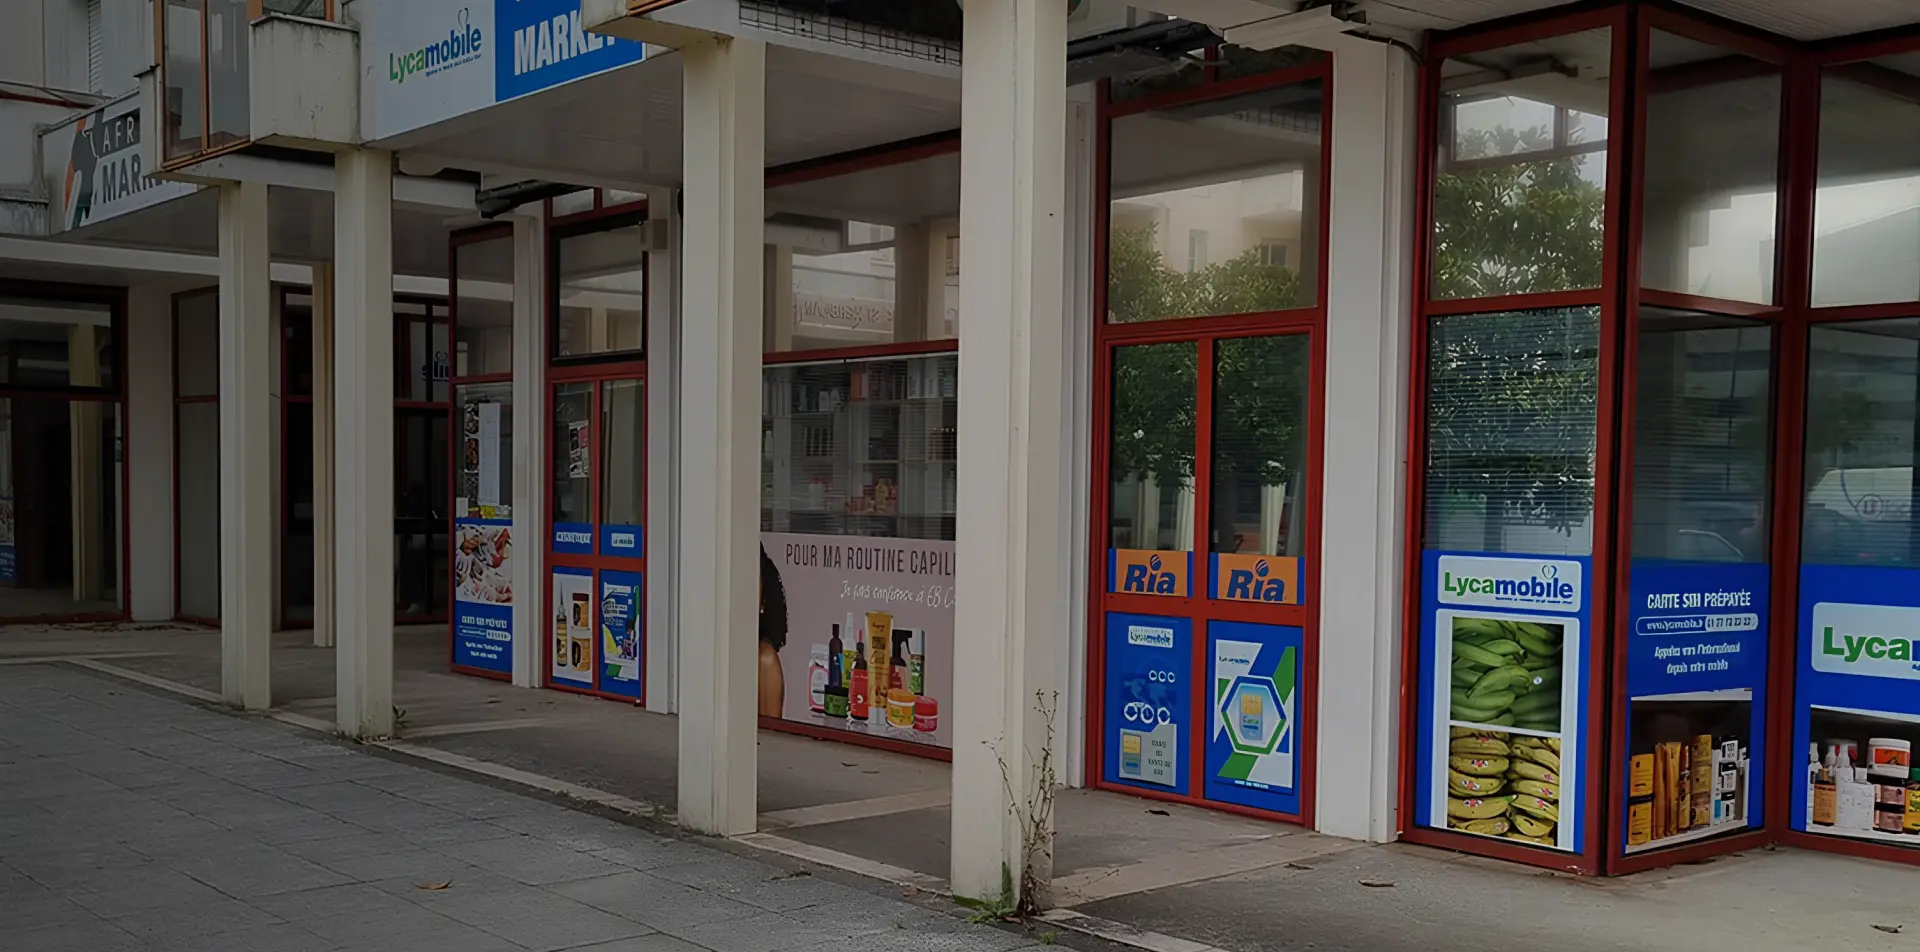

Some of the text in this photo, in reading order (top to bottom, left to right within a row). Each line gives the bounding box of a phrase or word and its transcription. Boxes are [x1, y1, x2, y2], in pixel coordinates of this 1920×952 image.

[389, 24, 482, 83] Lycamobile
[102, 154, 168, 204] MAR
[786, 544, 818, 567] POUR
[823, 545, 841, 568] MA
[847, 547, 904, 573] ROUTINE
[1124, 554, 1176, 594] Ria
[1227, 559, 1285, 602] Ria
[1444, 572, 1573, 599] Lycamobile
[1647, 593, 1680, 609] CARTE
[1823, 626, 1920, 663] Lyca
